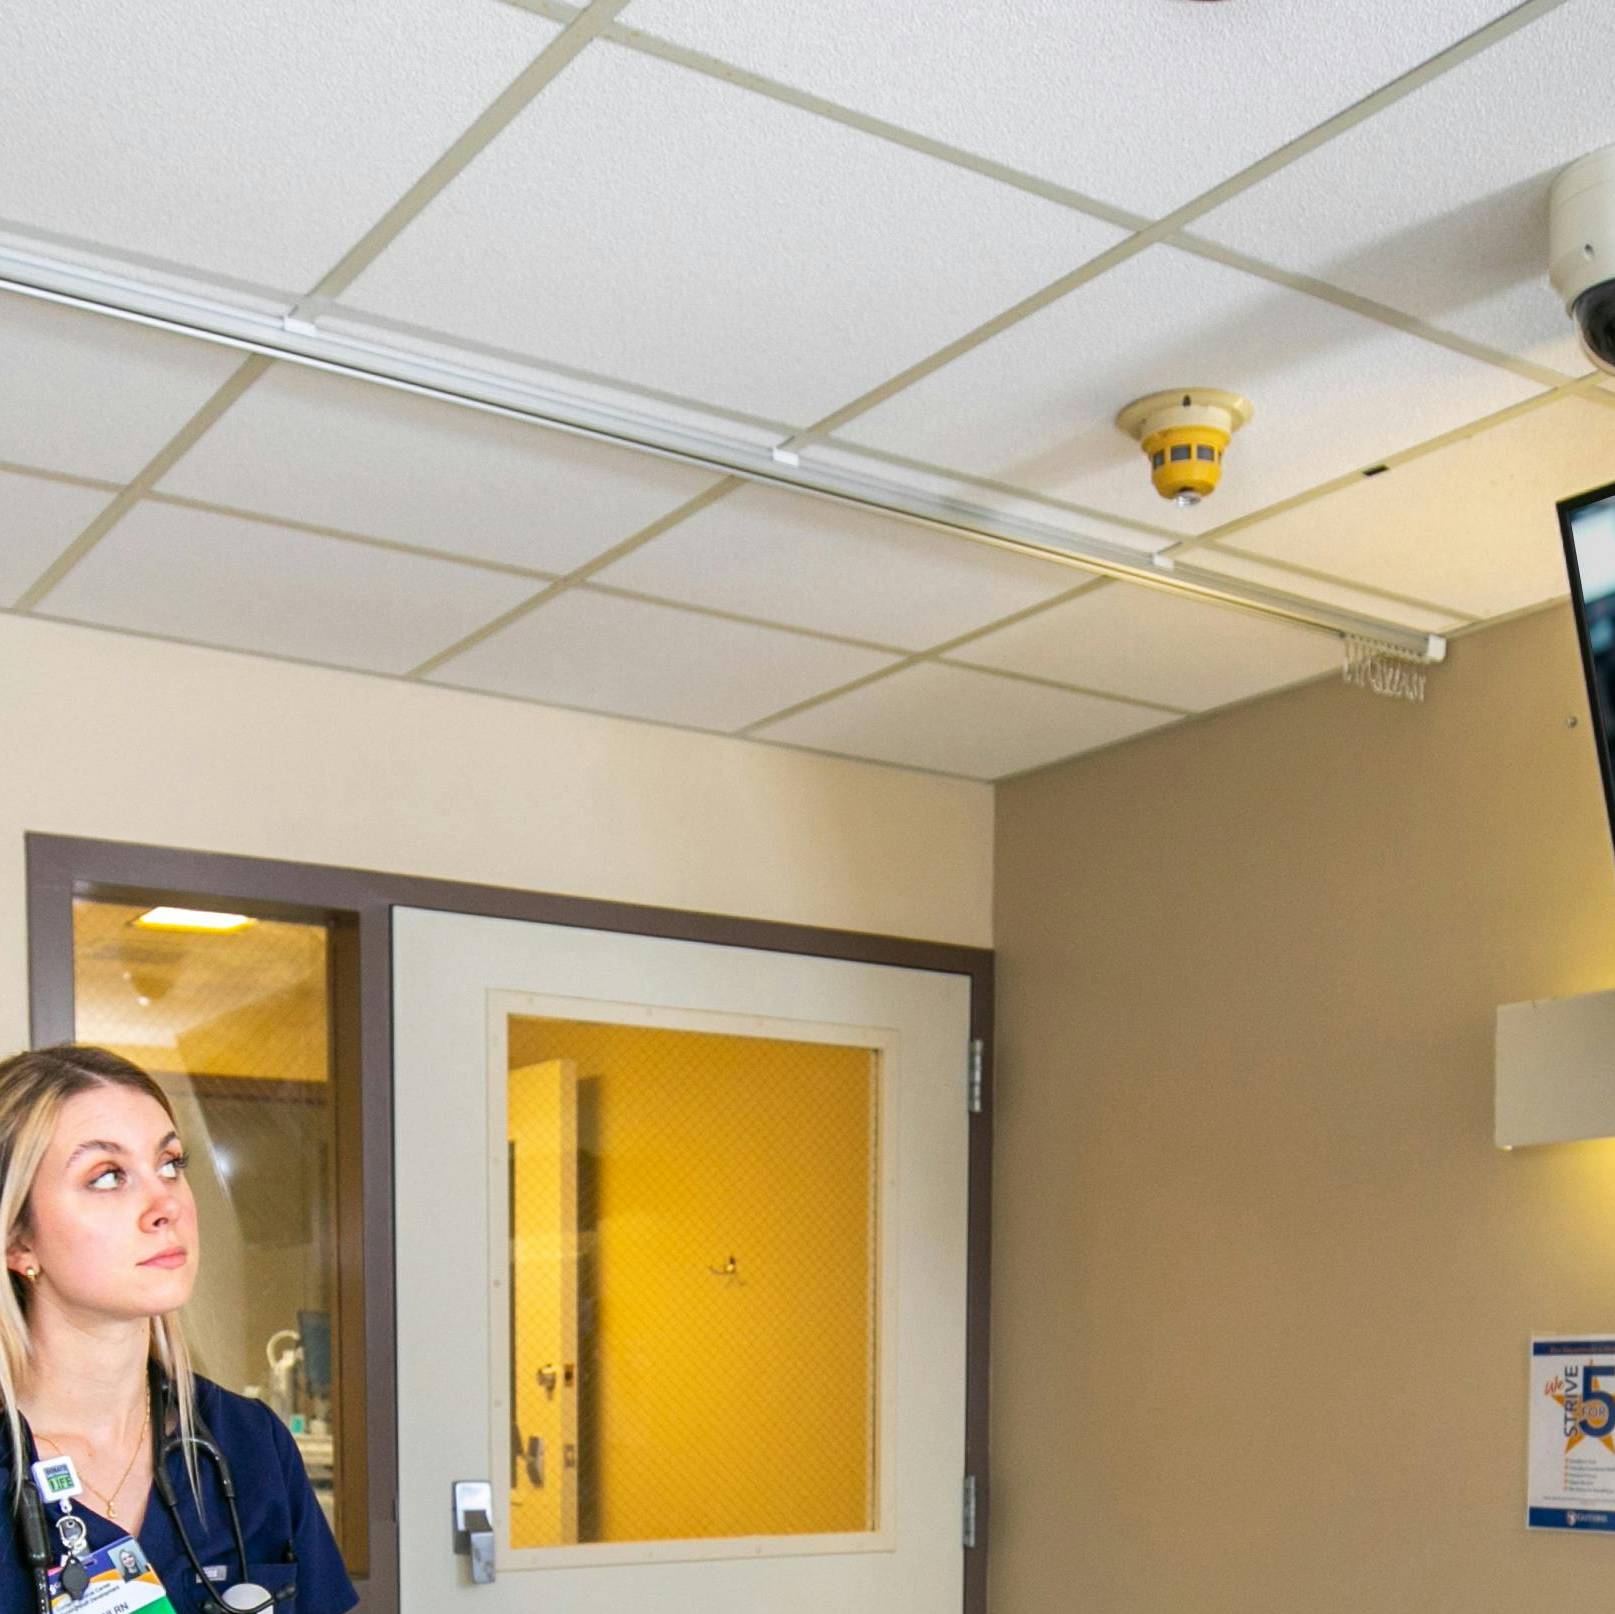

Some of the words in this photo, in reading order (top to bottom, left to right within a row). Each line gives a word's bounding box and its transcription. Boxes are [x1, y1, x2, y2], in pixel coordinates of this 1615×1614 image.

[1564, 1365, 1579, 1437] STRIVE
[1582, 1407, 1606, 1417] FOR
[50, 1477, 74, 1491] LIFE
